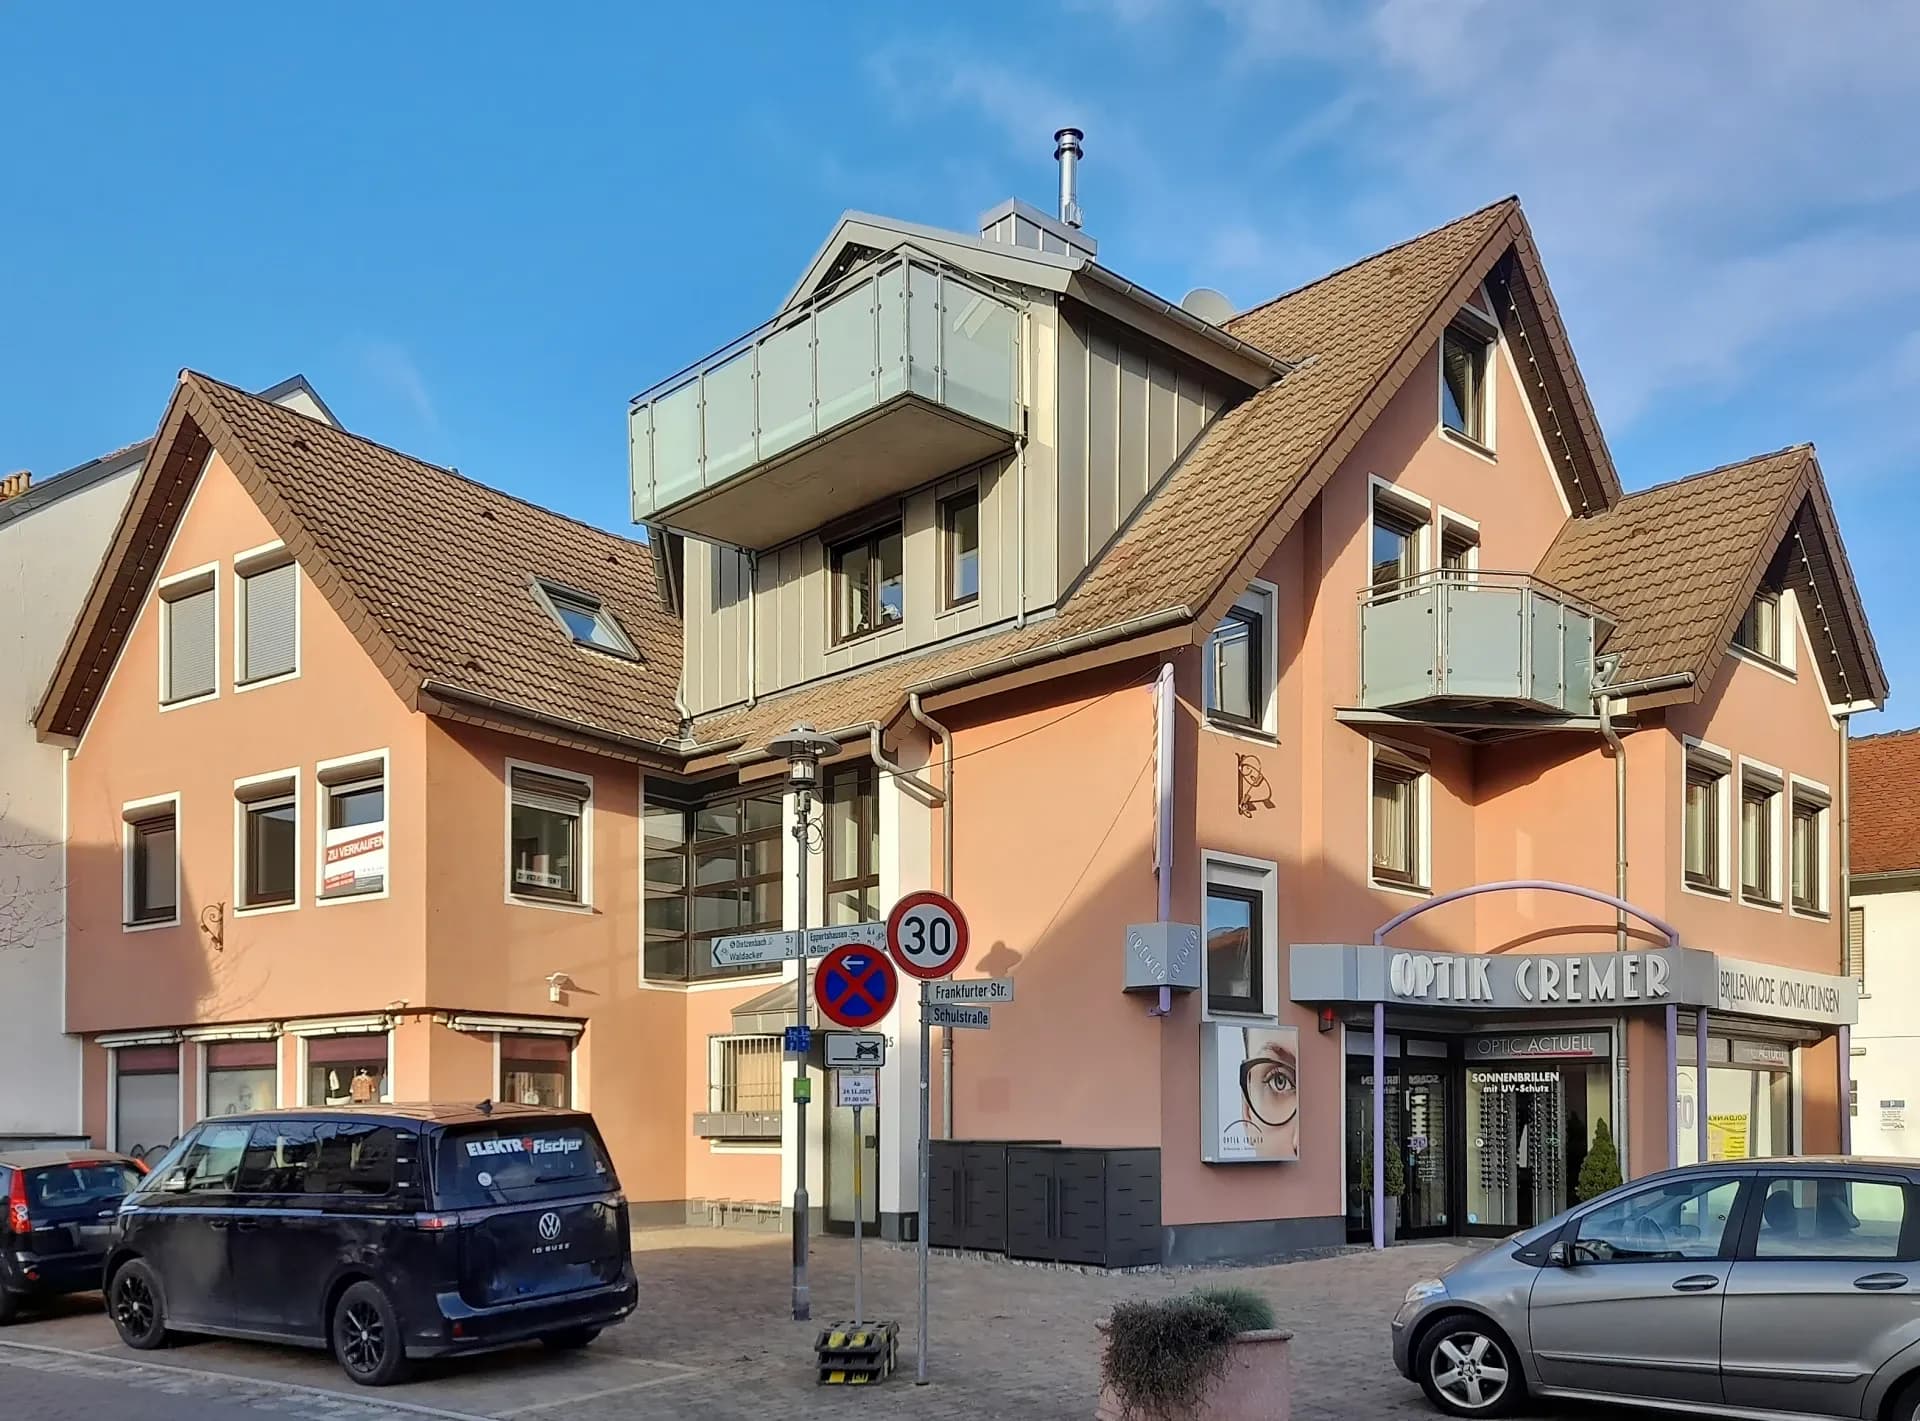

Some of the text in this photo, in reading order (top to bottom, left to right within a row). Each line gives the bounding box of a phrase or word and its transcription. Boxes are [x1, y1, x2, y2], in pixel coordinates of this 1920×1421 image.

[327, 834, 384, 861] ZU VERKAUFEN
[736, 936, 767, 949] Dietzenbach
[904, 916, 951, 956] 30
[729, 951, 763, 961] Waldacker
[1129, 931, 1166, 981] CREMER
[1390, 952, 1670, 1002] OPTIK CREMER
[936, 982, 1007, 999] Frankfurter Str.
[1720, 970, 1840, 1013] BRILLENMODE KONTAKTLINSEN
[934, 1007, 988, 1025] Schulstraße
[1477, 1035, 1595, 1054] OPTIC ACTUELL
[1471, 1071, 1560, 1083] SONNENBRILLEN
[1483, 1084, 1549, 1093] mit UV-Schutz
[533, 1137, 583, 1154] Fischer
